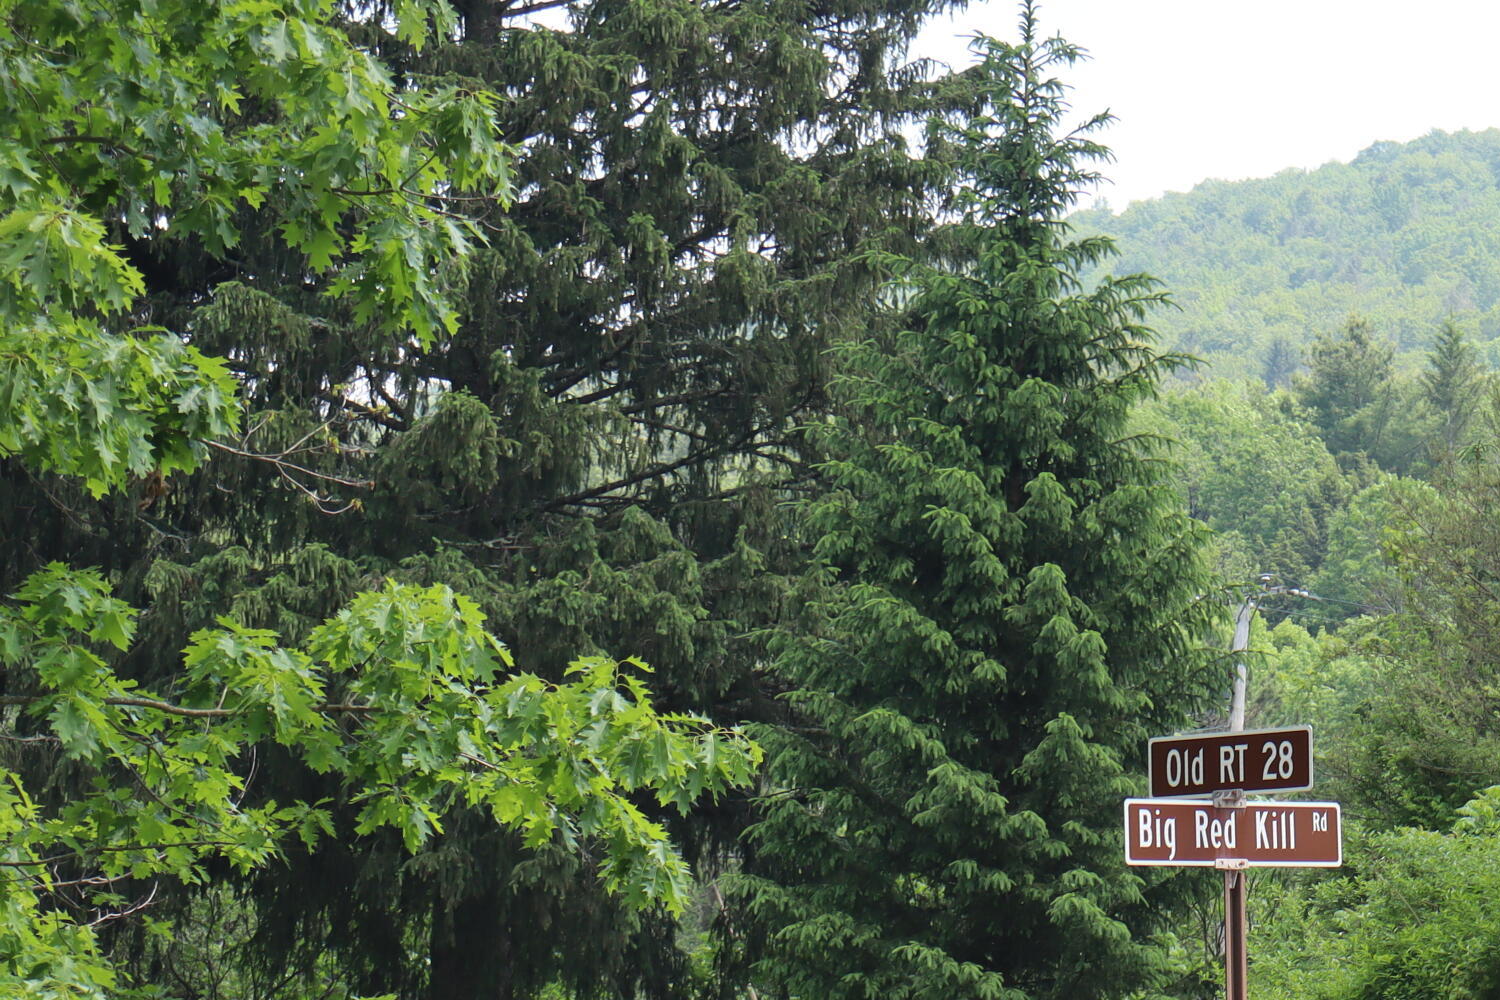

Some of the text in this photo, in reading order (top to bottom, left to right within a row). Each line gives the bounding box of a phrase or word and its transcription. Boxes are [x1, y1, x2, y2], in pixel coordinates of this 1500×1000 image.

[1166, 740, 1294, 788] Old RT 28
[1139, 809, 1328, 860] Big Red Kill Rd
